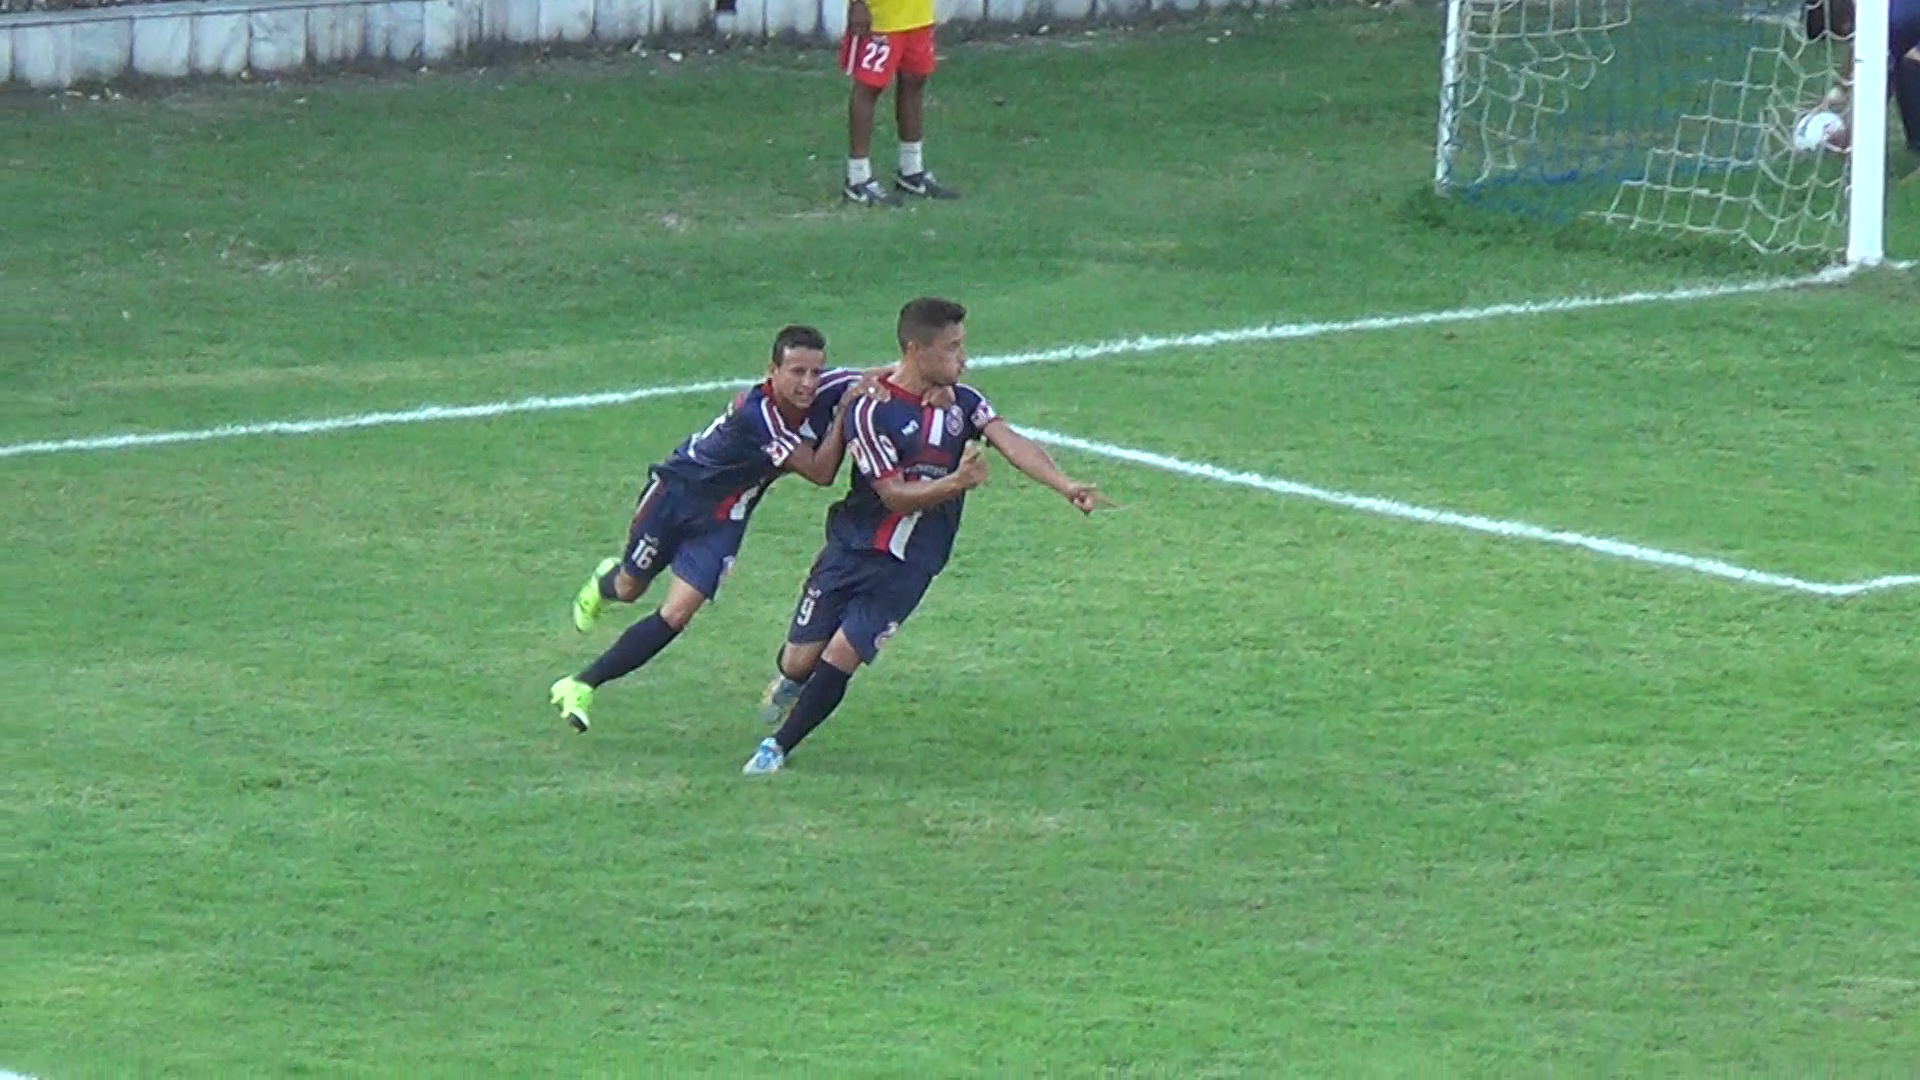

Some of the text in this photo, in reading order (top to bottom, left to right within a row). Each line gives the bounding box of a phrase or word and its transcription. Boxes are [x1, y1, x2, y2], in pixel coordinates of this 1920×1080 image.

[861, 43, 890, 72] 22
[631, 539, 658, 570] 16
[797, 597, 816, 626] 9
